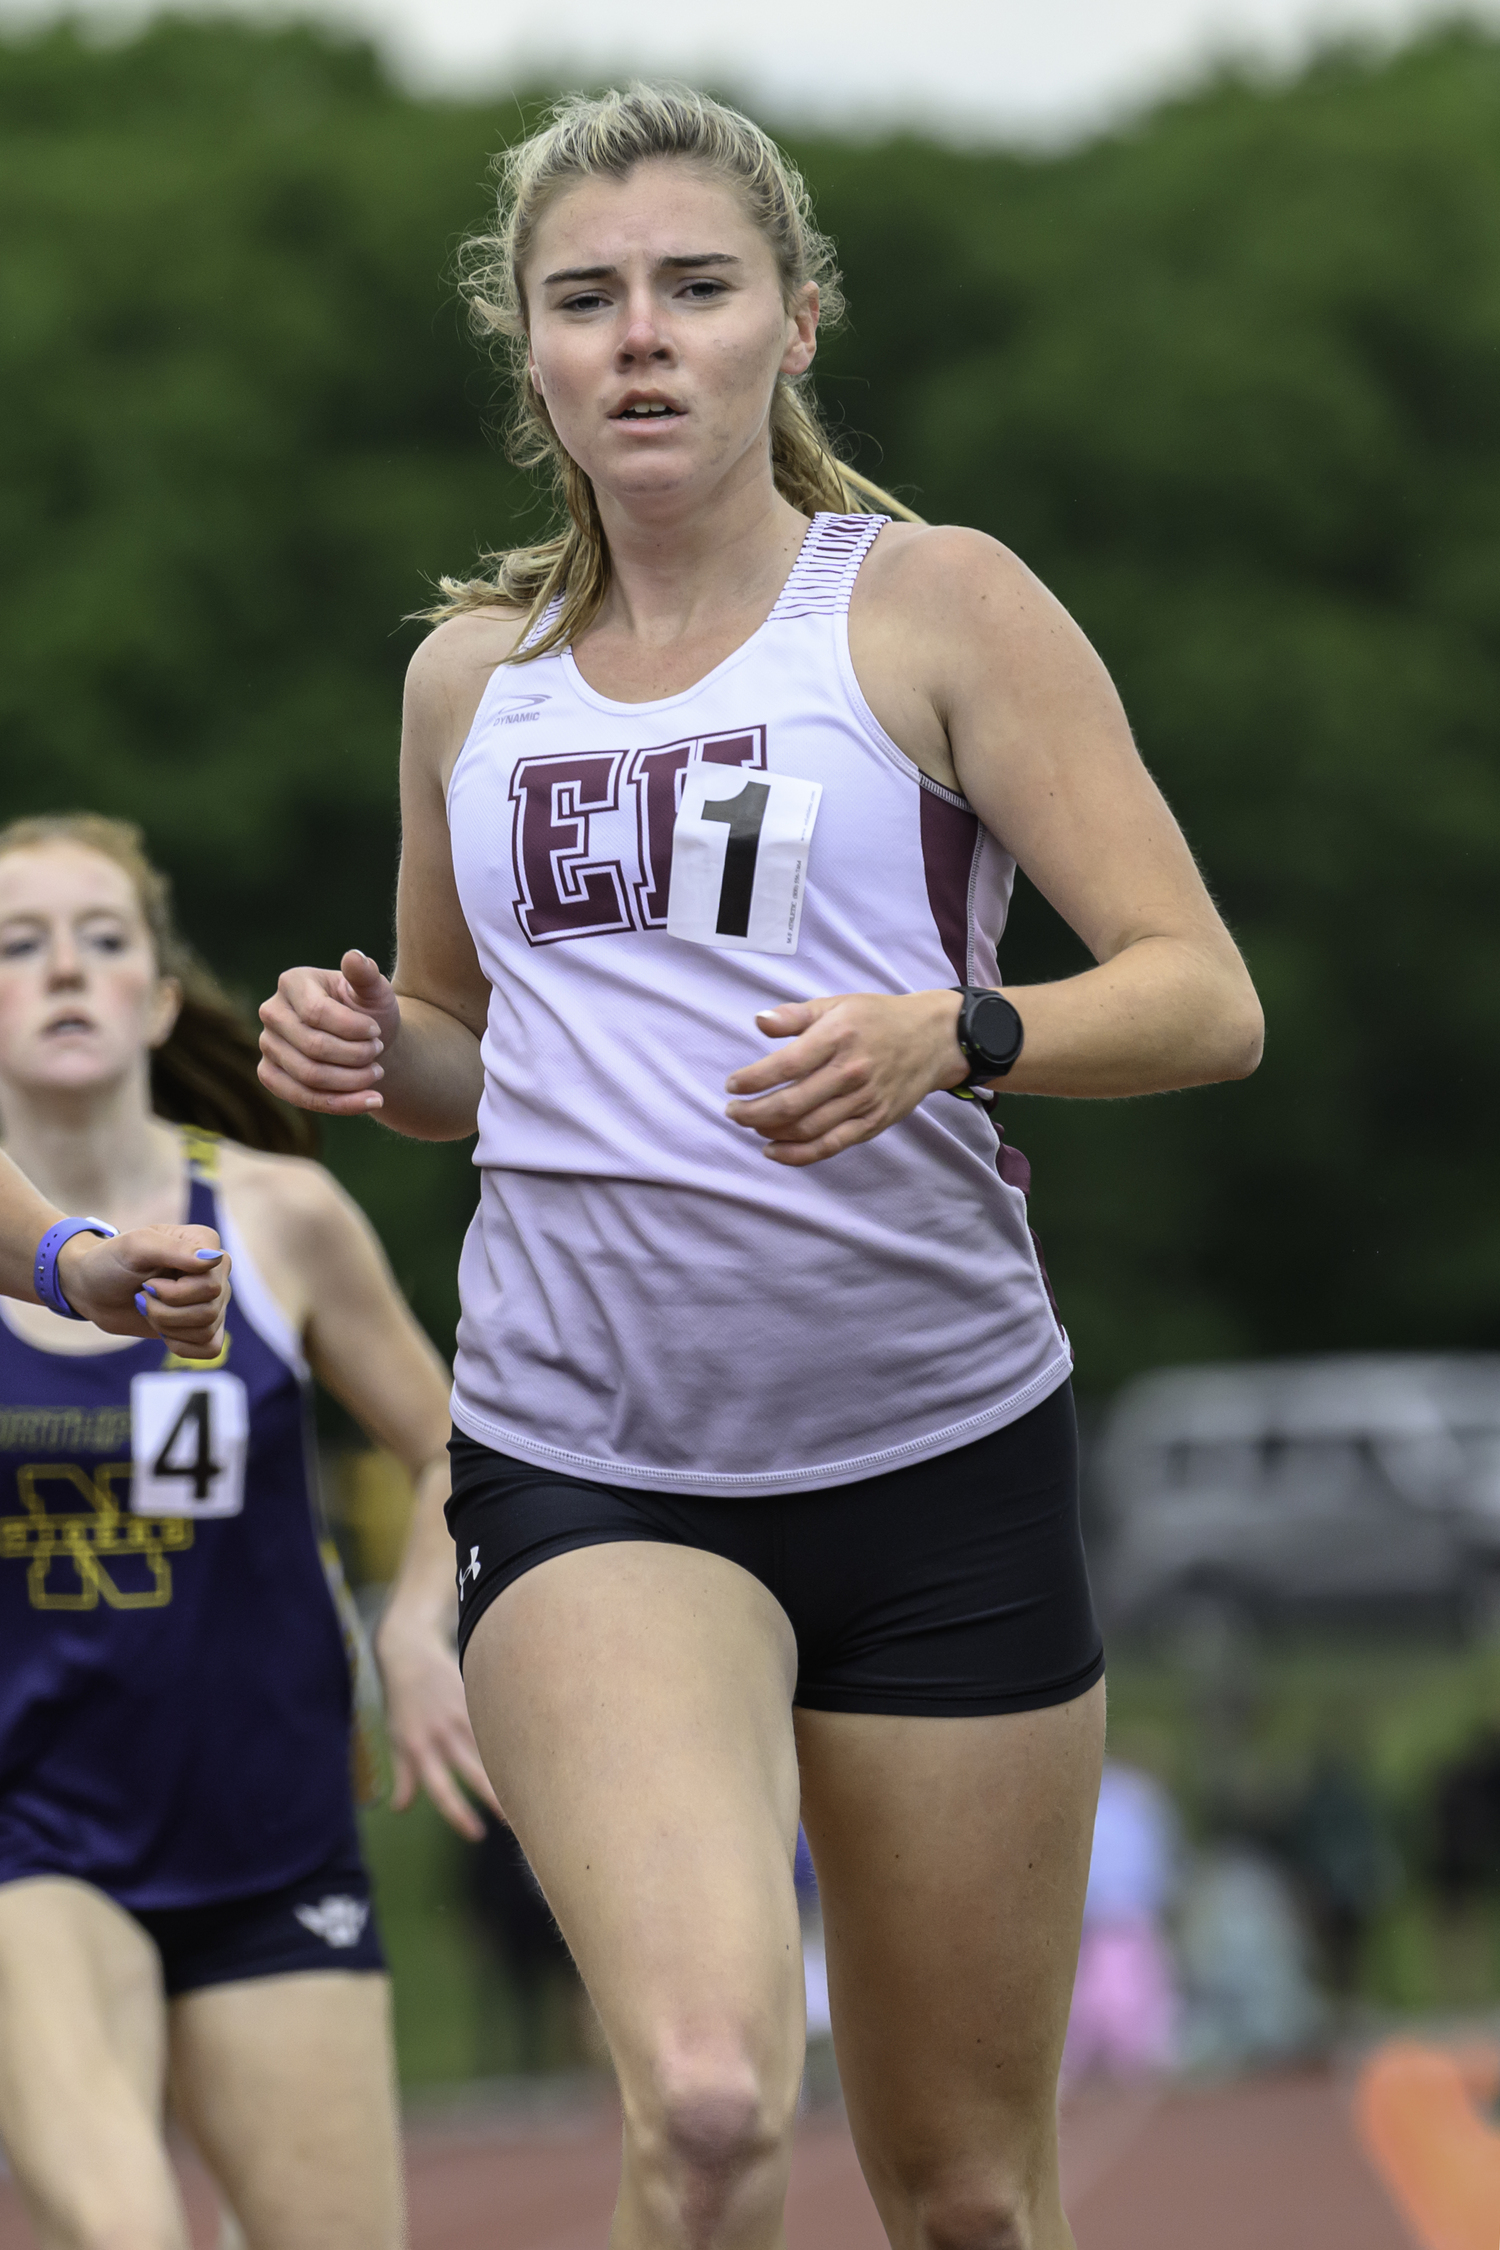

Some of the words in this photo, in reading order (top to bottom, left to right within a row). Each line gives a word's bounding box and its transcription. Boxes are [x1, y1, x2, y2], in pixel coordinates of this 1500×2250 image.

[493, 711, 540, 727] DYNAMIC
[700, 781, 771, 938] 1
[153, 1390, 222, 1502] 4
